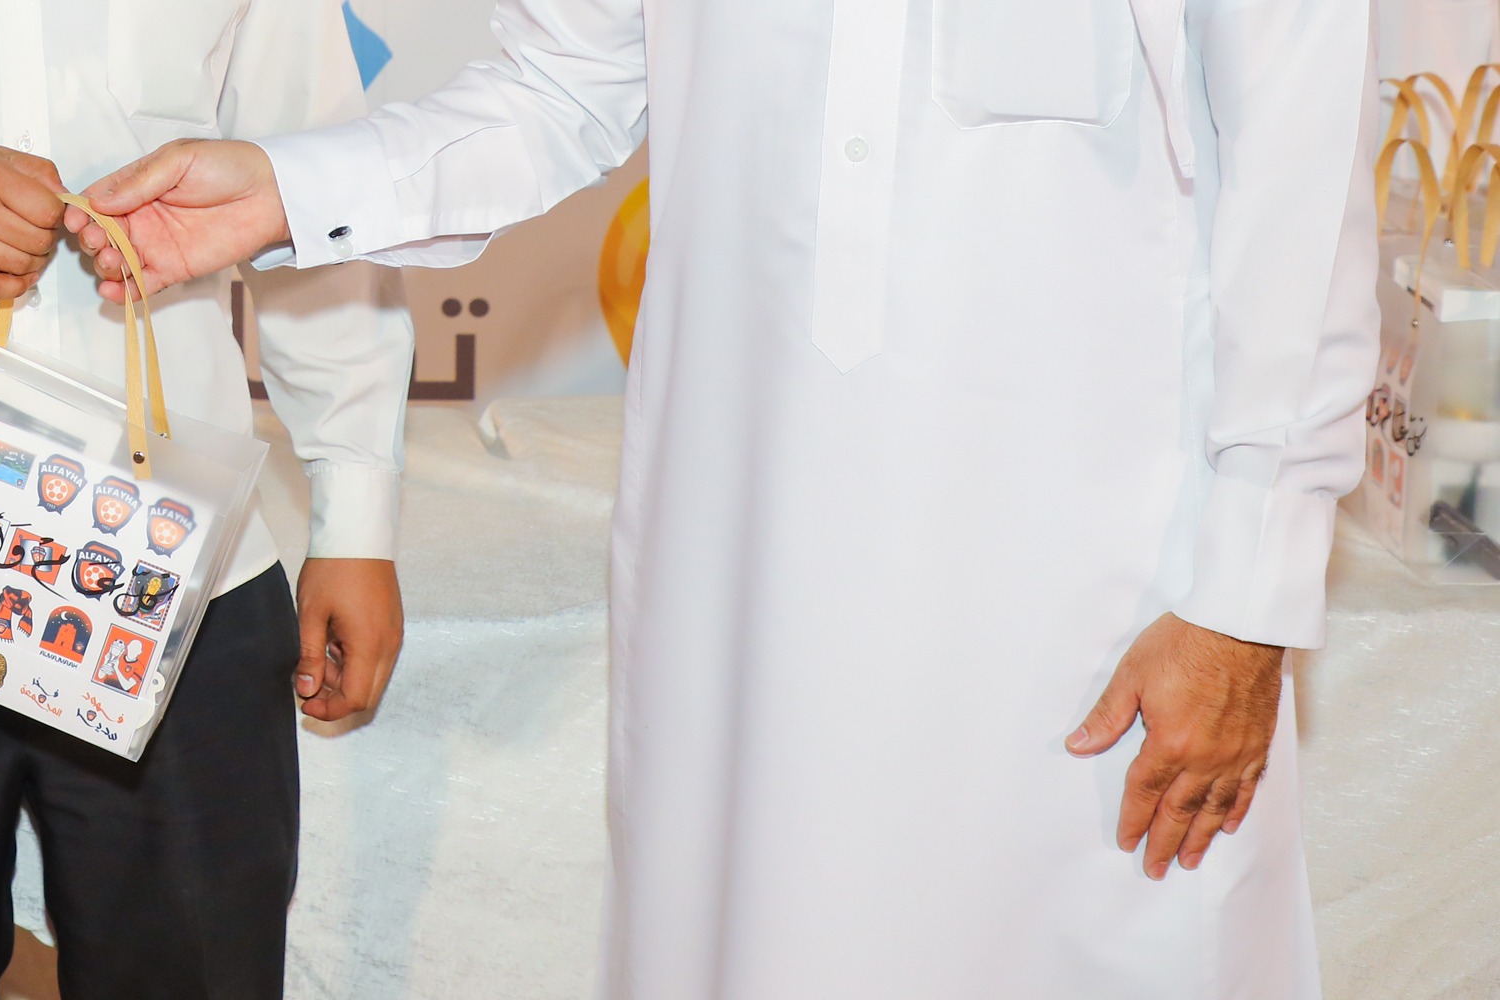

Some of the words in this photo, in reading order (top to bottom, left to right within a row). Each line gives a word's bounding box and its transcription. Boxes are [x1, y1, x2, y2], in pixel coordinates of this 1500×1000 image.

[40, 464, 83, 487] ALFAYHA
[95, 486, 138, 509] ALFAYHA
[150, 508, 192, 531] ALFAYHA
[78, 551, 121, 575] ALFAYHA
